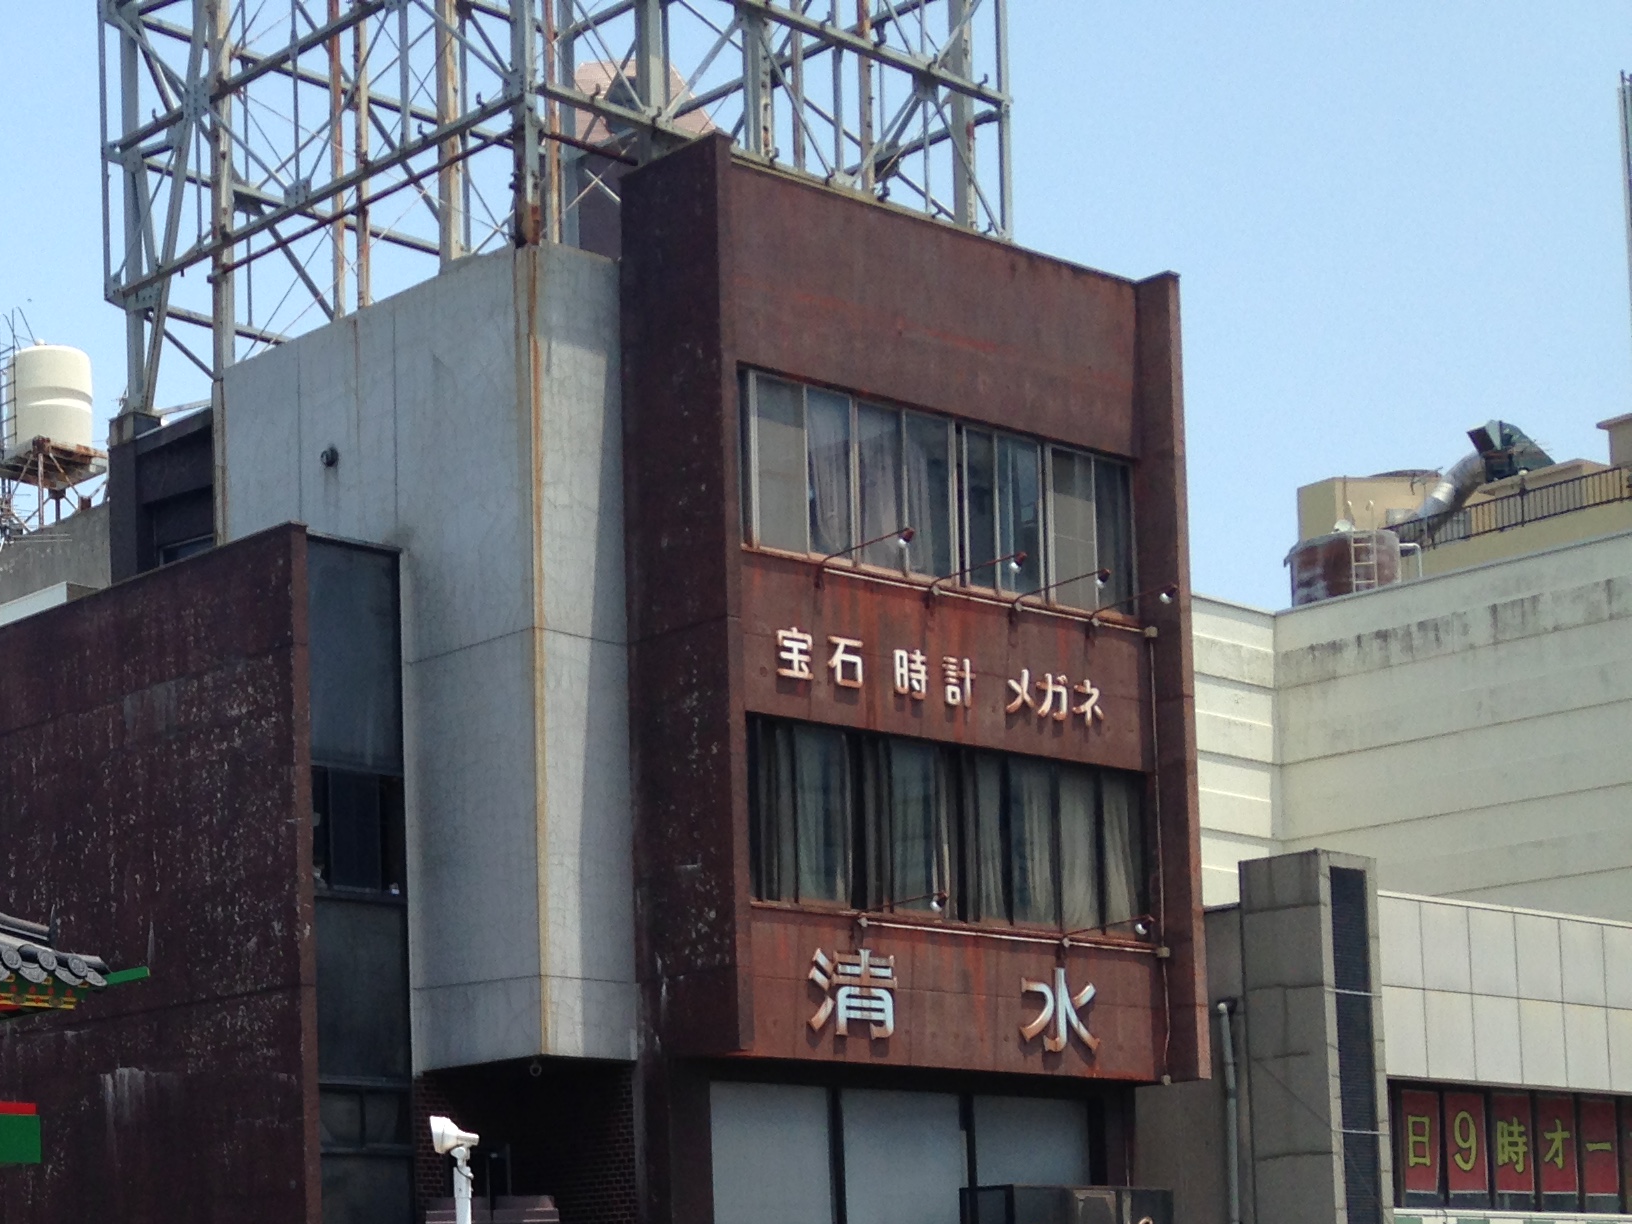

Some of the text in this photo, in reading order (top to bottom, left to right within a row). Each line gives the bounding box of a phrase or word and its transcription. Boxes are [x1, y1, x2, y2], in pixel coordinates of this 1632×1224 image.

[776, 626, 1105, 727] 宝石 時計 メガネ
[807, 947, 1101, 1053] 清水
